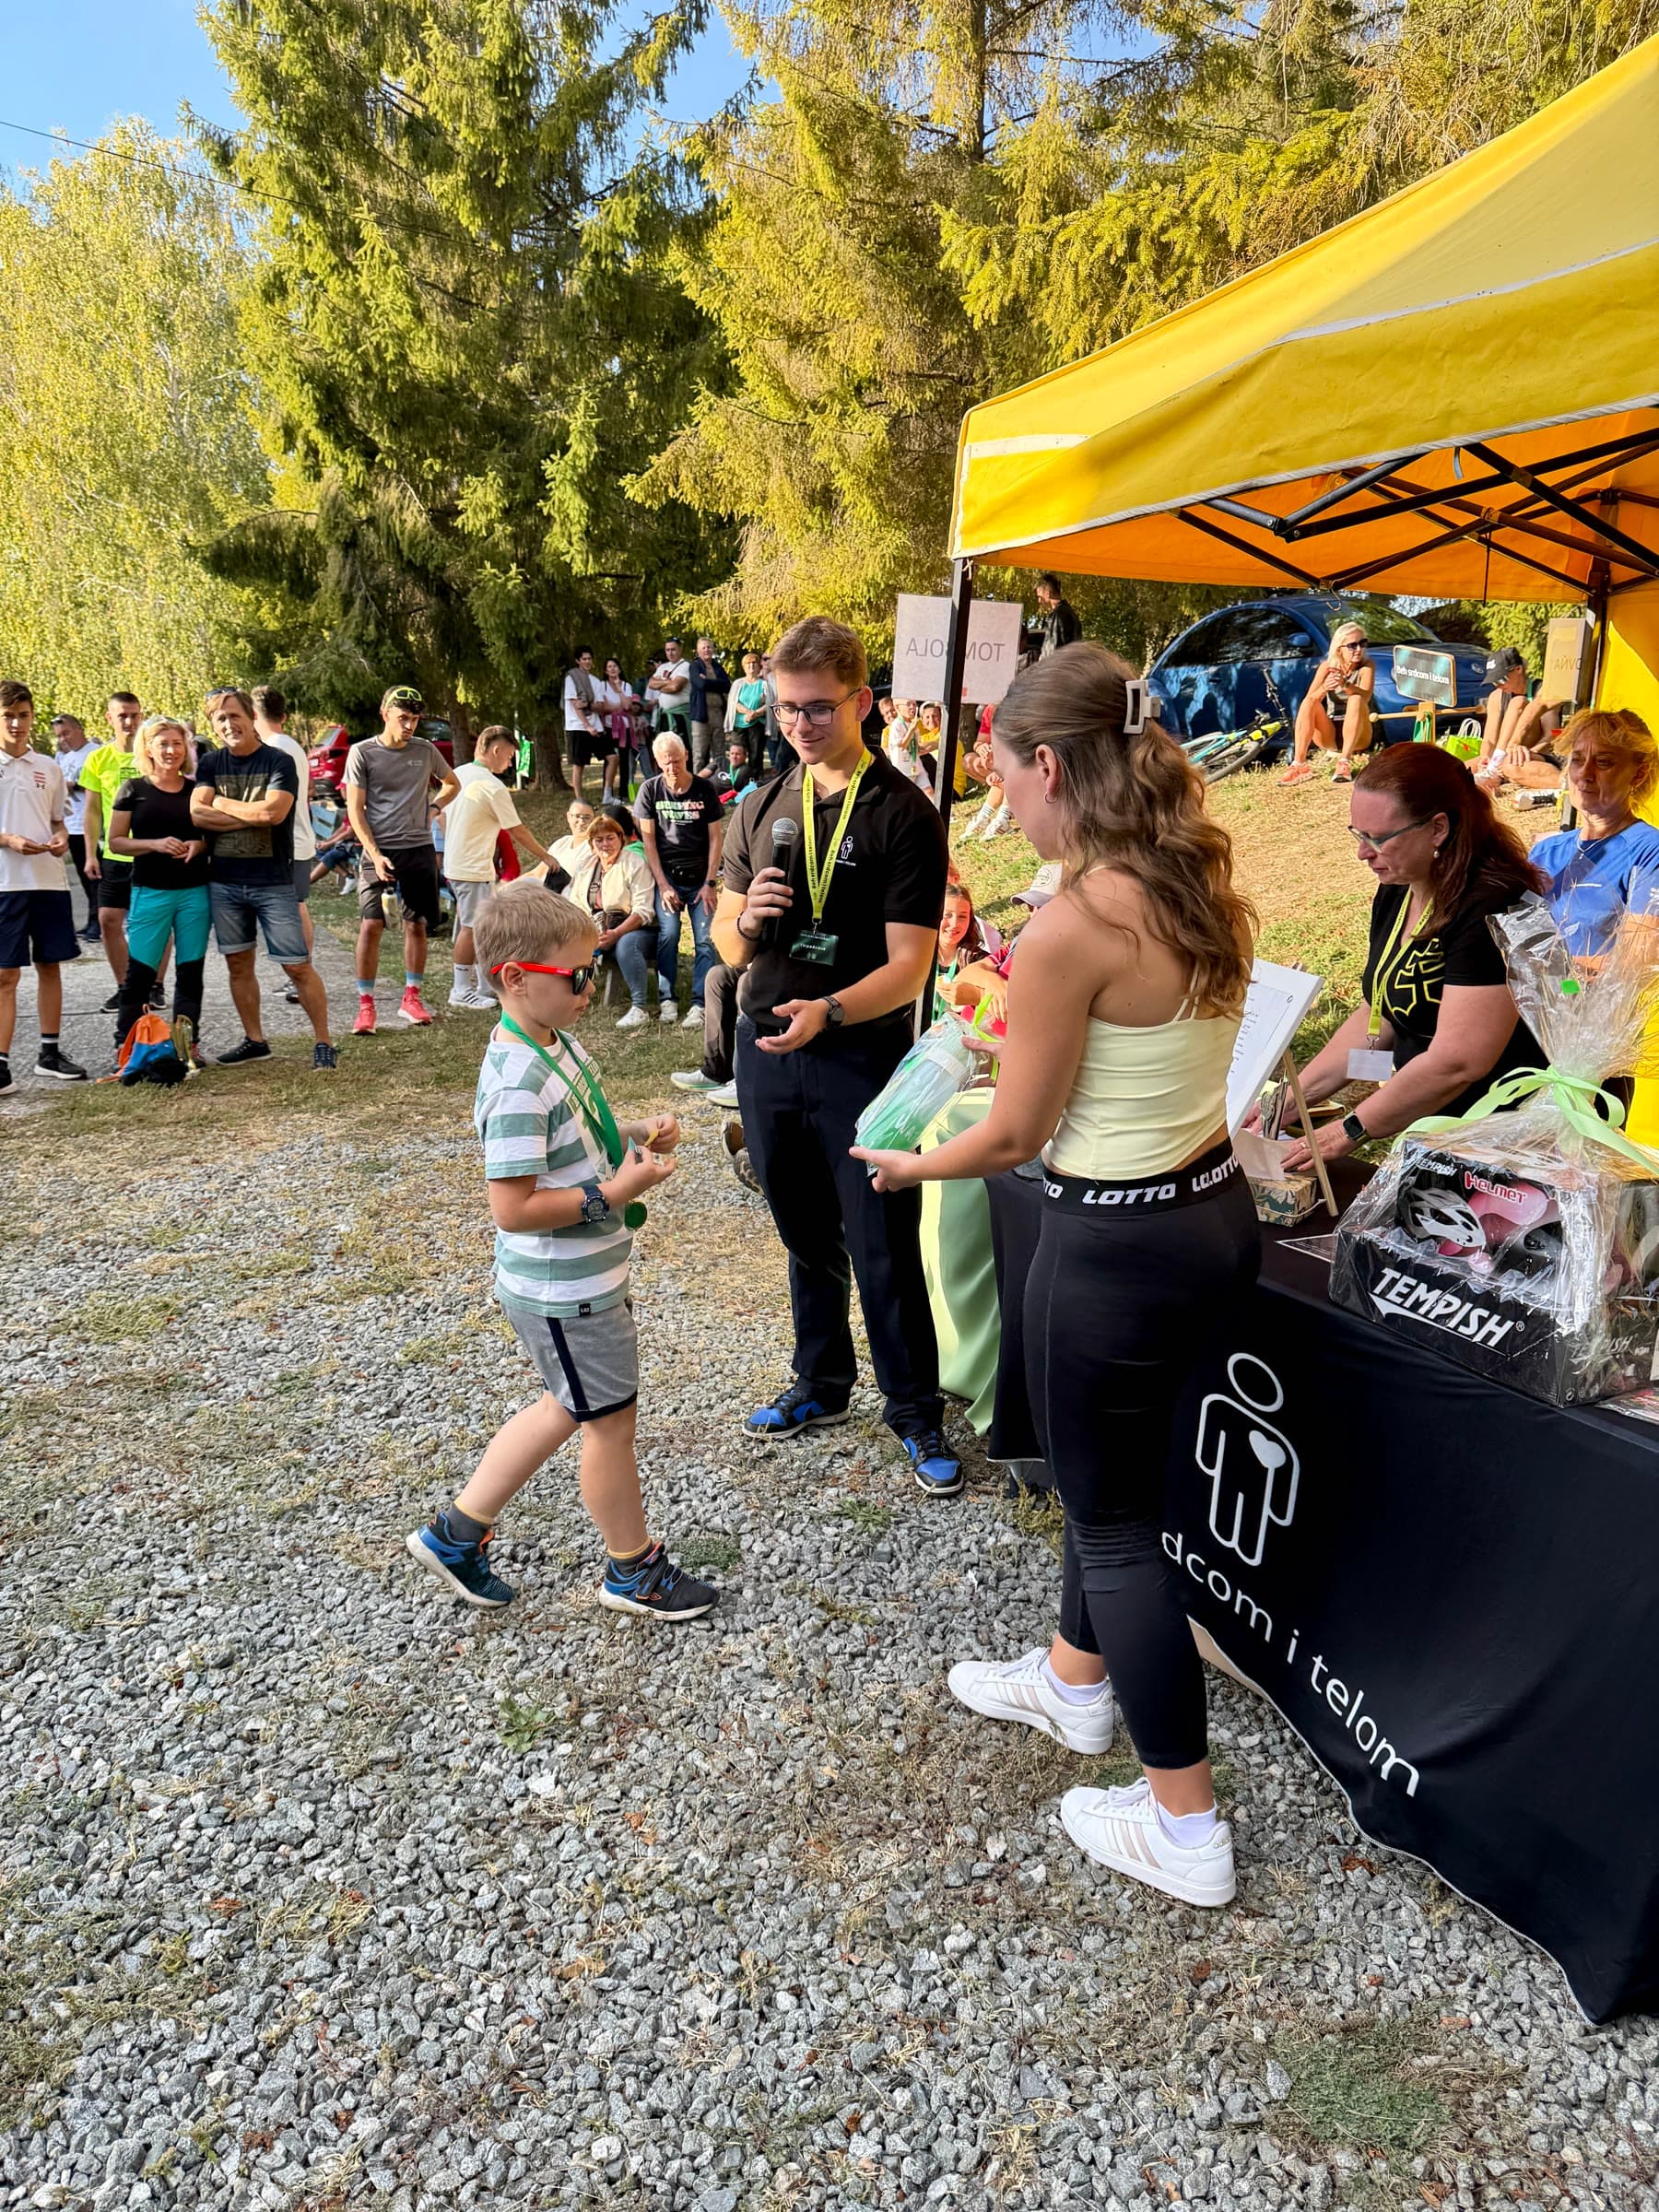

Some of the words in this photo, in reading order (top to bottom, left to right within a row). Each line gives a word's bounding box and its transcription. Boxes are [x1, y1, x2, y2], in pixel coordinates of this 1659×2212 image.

[1396, 665, 1407, 676] Beh
[1407, 668, 1430, 680] srdcom
[1432, 674, 1450, 685] telom
[1082, 1182, 1177, 1206] LOTTO
[1287, 1629, 1300, 1664] i
[1312, 1655, 1419, 1796] telom
